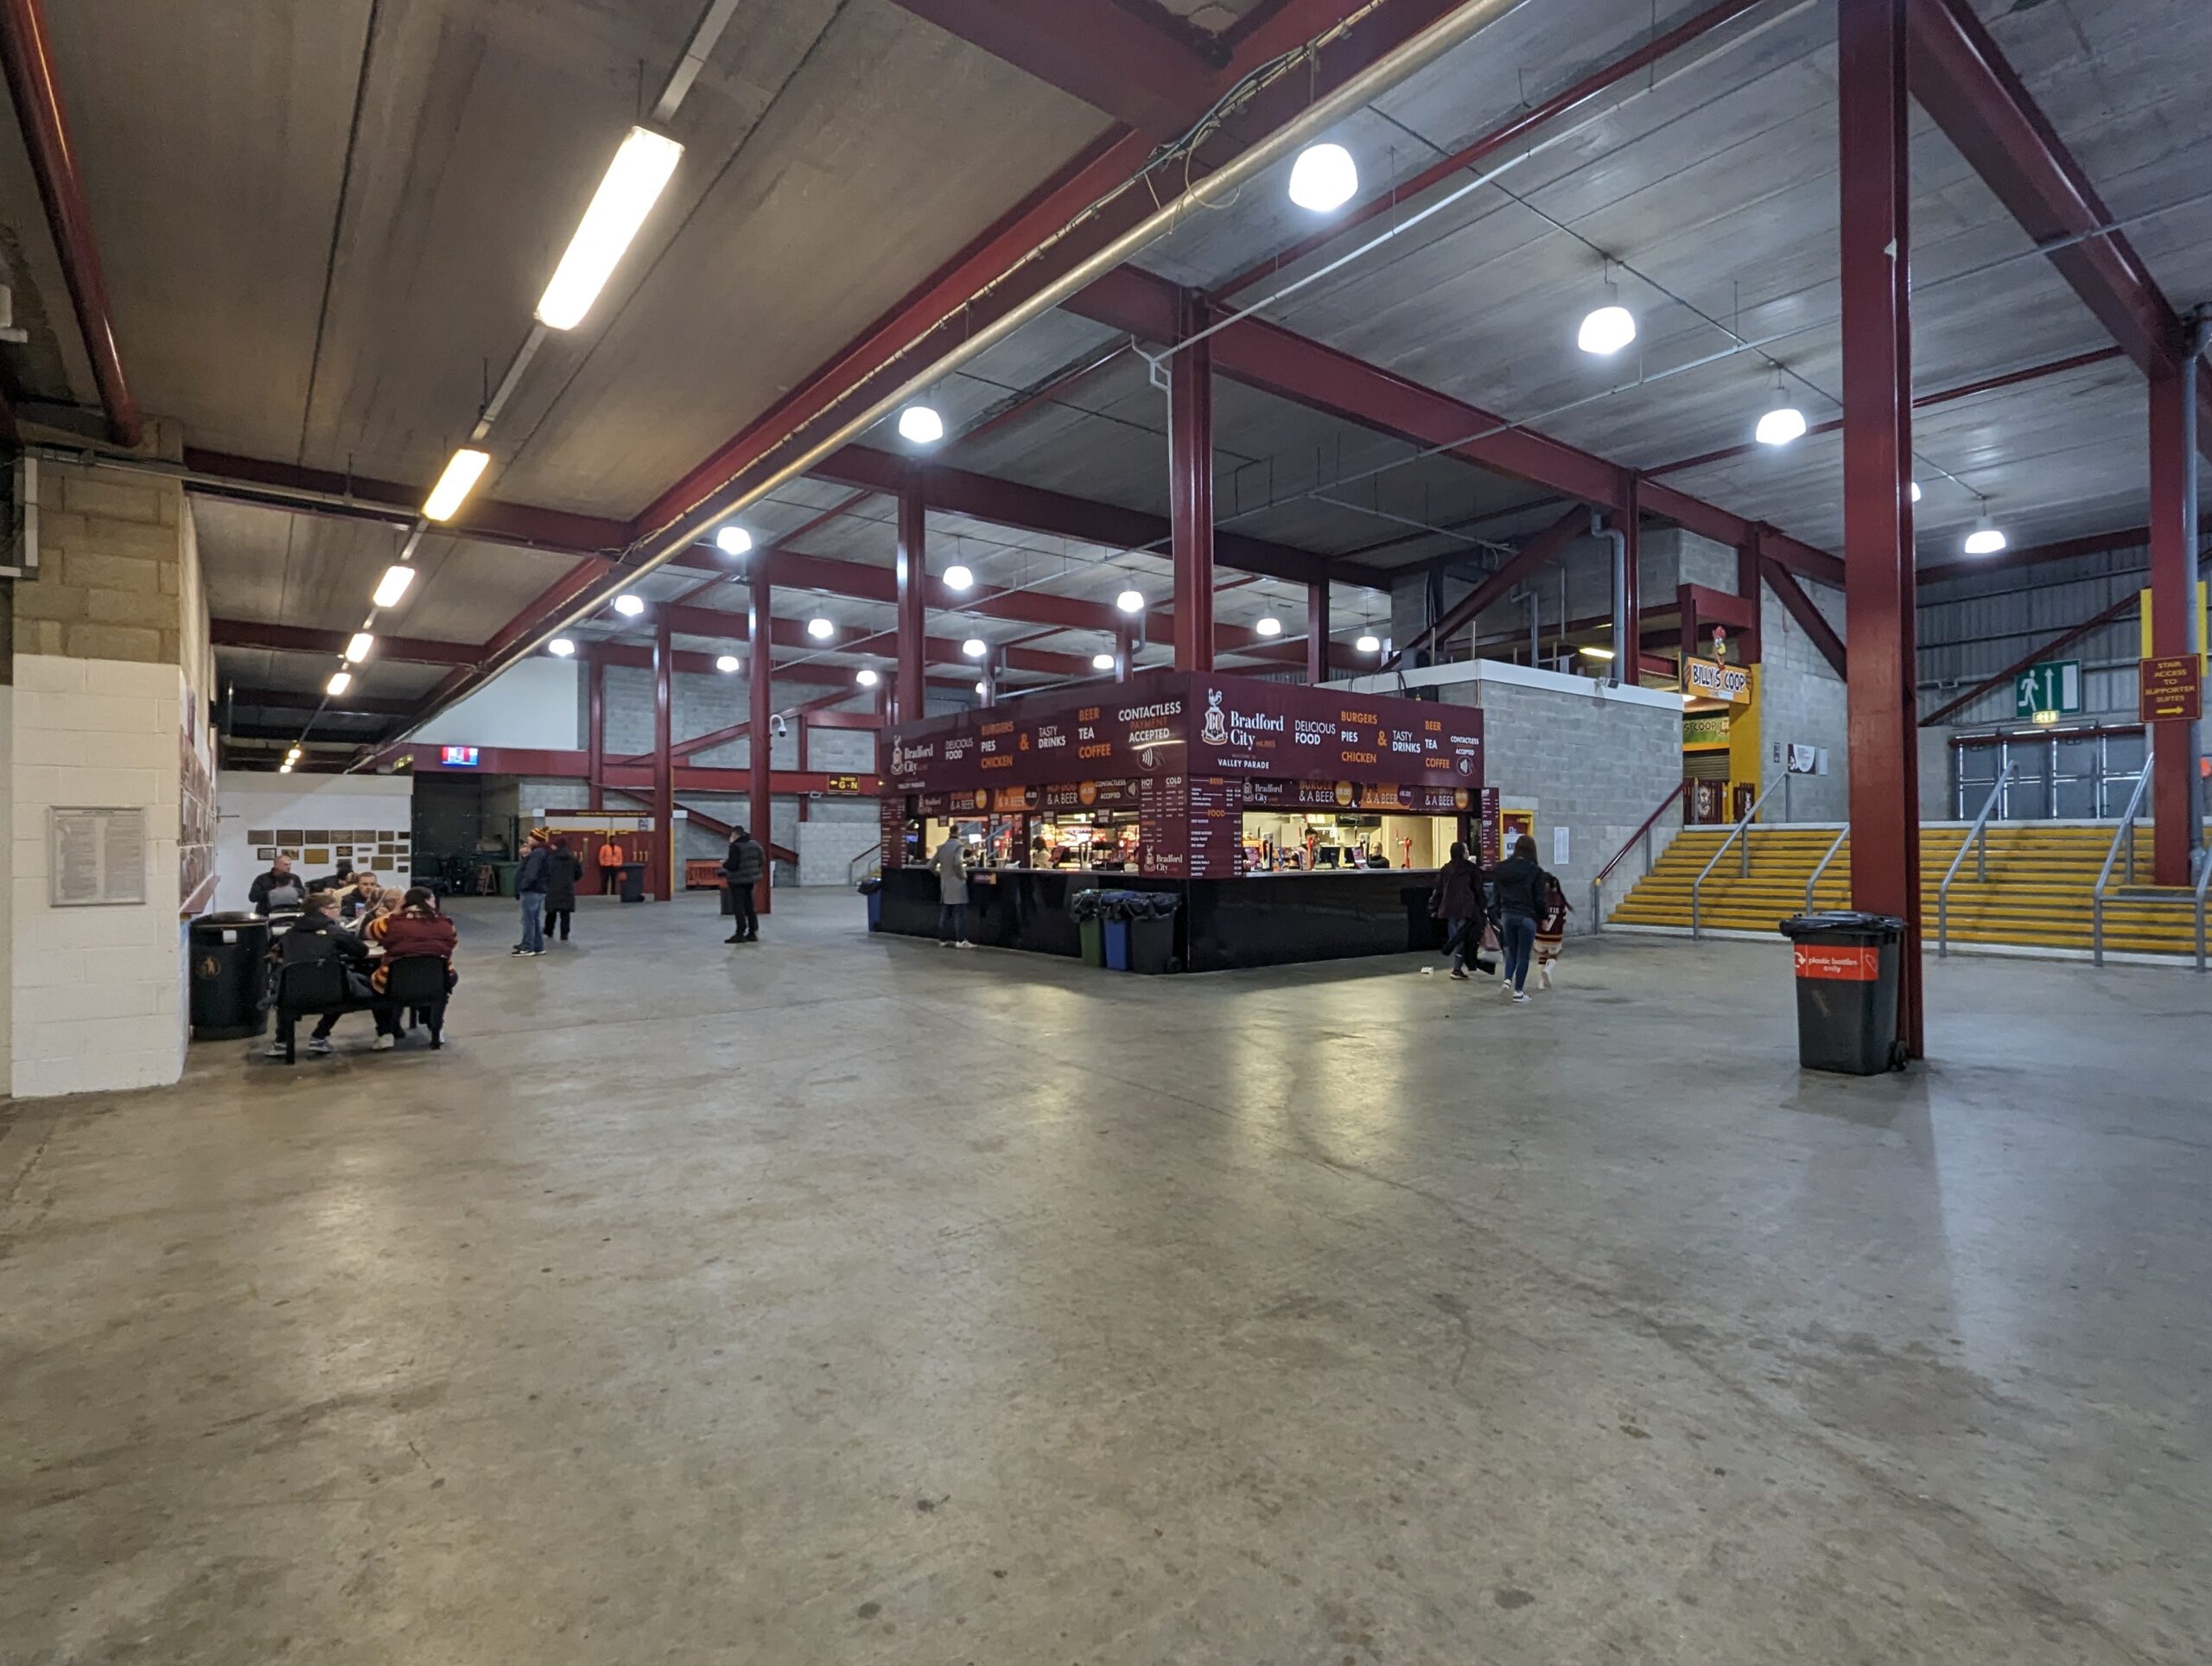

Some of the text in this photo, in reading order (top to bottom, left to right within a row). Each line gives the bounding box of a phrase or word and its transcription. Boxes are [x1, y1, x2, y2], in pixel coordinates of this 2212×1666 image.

[1693, 664, 1745, 691] BILLY'S COOP
[2154, 669, 2187, 677] ACCESS
[1079, 707, 1100, 722] BEER
[1118, 701, 1181, 722] CONTACTLESS
[1341, 710, 1378, 725] BURGERS
[1130, 716, 1167, 729] PAYMENT
[1230, 710, 1284, 731] Bradford
[1295, 720, 1336, 734] DELICIOUS
[1425, 721, 1442, 731] BEER
[1694, 722, 1716, 731] COOP
[1039, 726, 1058, 737] TASTY
[1078, 727, 1095, 741] TEA
[1128, 728, 1170, 743] ACCEPTED
[1341, 730, 1358, 743] PIES
[1393, 730, 1413, 742] TASTY
[945, 737, 974, 750] DELICIOUS
[1020, 734, 1029, 751] &
[1039, 735, 1066, 748] DRINKS
[1230, 729, 1255, 751] City
[1295, 733, 1321, 745] FOOD
[1377, 730, 1387, 747] &
[1425, 739, 1438, 750] TEA
[1450, 735, 1479, 746] CONTACTLESS
[905, 744, 933, 760] Bradford
[981, 741, 996, 753] PIES
[1078, 743, 1111, 759] COFFEE
[1393, 741, 1421, 754] DRINKS
[945, 750, 963, 760] FOOD
[1341, 751, 1376, 764] CHICKEN
[904, 760, 918, 774] City
[981, 756, 1013, 769] CHICKEN
[1217, 759, 1269, 769] VALLEY PARADE
[1426, 758, 1450, 769] COFFEE
[1255, 784, 1282, 793] Bradford
[1047, 792, 1078, 804] & A BEER
[1255, 793, 1268, 804] City
[1299, 790, 1334, 803] & A BEER
[1367, 792, 1398, 804] & A BEER
[1425, 795, 1454, 806] & A BEER
[1156, 854, 1183, 863] Bradford
[1156, 863, 1168, 874] City
